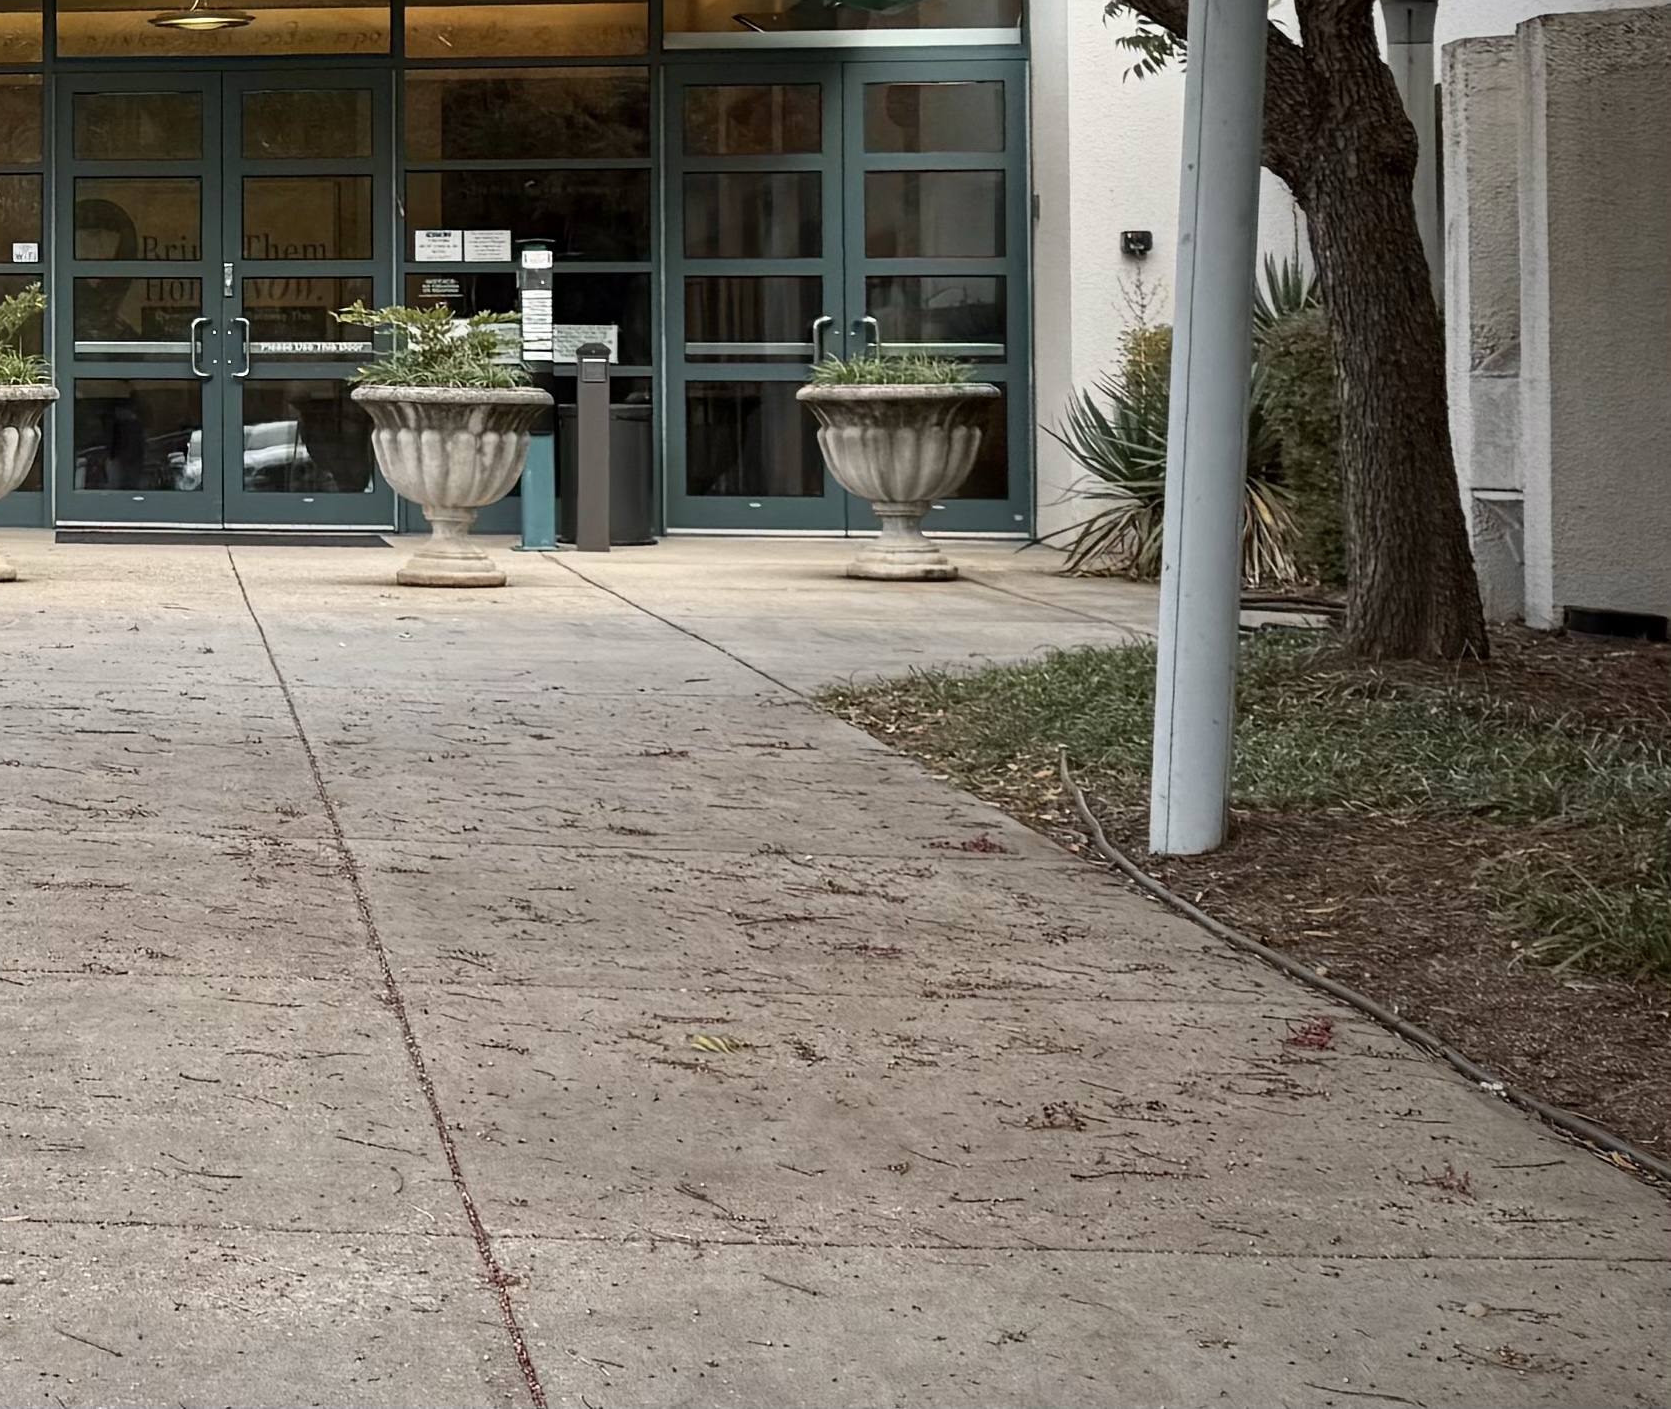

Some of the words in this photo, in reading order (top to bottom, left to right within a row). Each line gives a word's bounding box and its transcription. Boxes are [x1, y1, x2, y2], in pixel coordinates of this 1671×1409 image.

[294, 342, 314, 352] Use
[315, 342, 337, 352] This
[339, 342, 364, 352] Door
